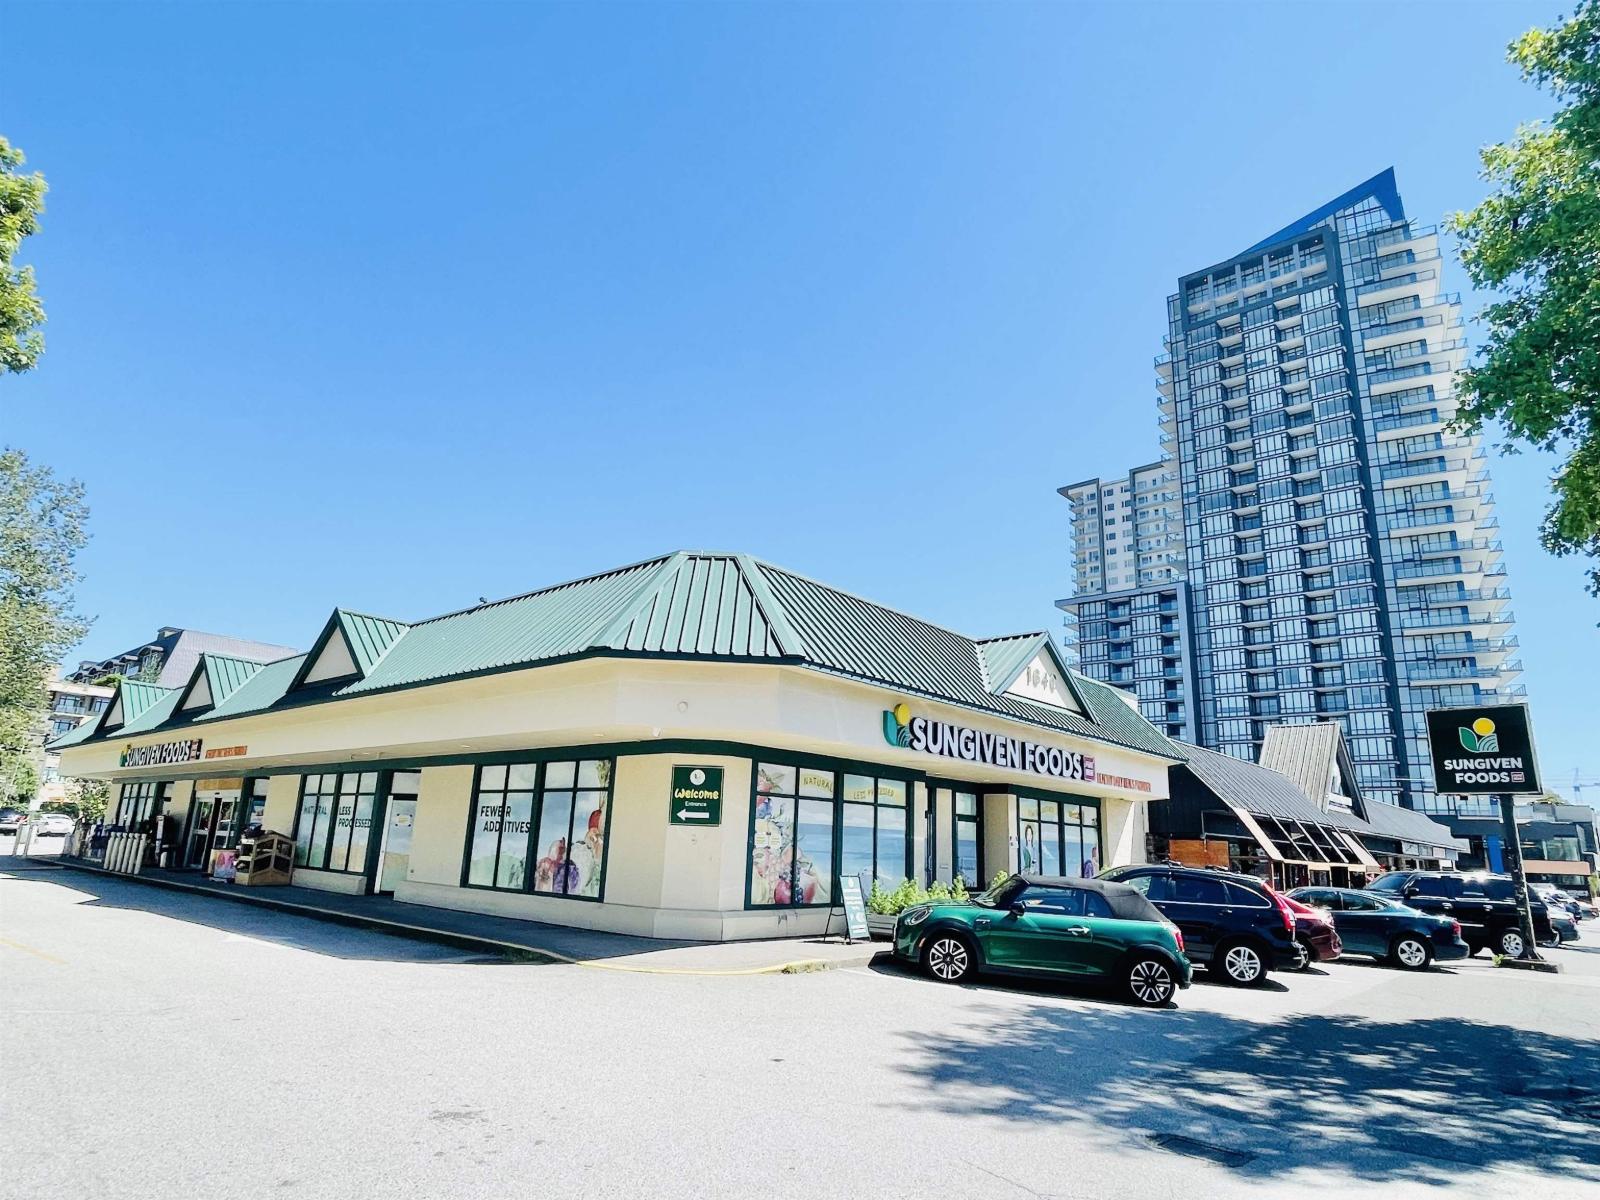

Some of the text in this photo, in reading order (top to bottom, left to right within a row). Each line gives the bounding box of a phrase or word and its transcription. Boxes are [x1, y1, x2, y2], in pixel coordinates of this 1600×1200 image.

[1026, 666, 1057, 694] 1640
[125, 744, 161, 767] SUNGIVEN
[161, 741, 191, 763] FOODS
[910, 717, 1023, 769] SUNGIVEN
[1025, 741, 1082, 780] FOODS
[1444, 757, 1523, 770] SUNGIVEN
[1455, 772, 1510, 783] FOODS
[803, 776, 833, 793] NATURAL
[674, 788, 719, 800] Welcome
[338, 806, 351, 816] LESS
[480, 805, 511, 818] FEWER
[338, 818, 371, 829] PROCESSED
[483, 821, 531, 834] ADDITIVES
